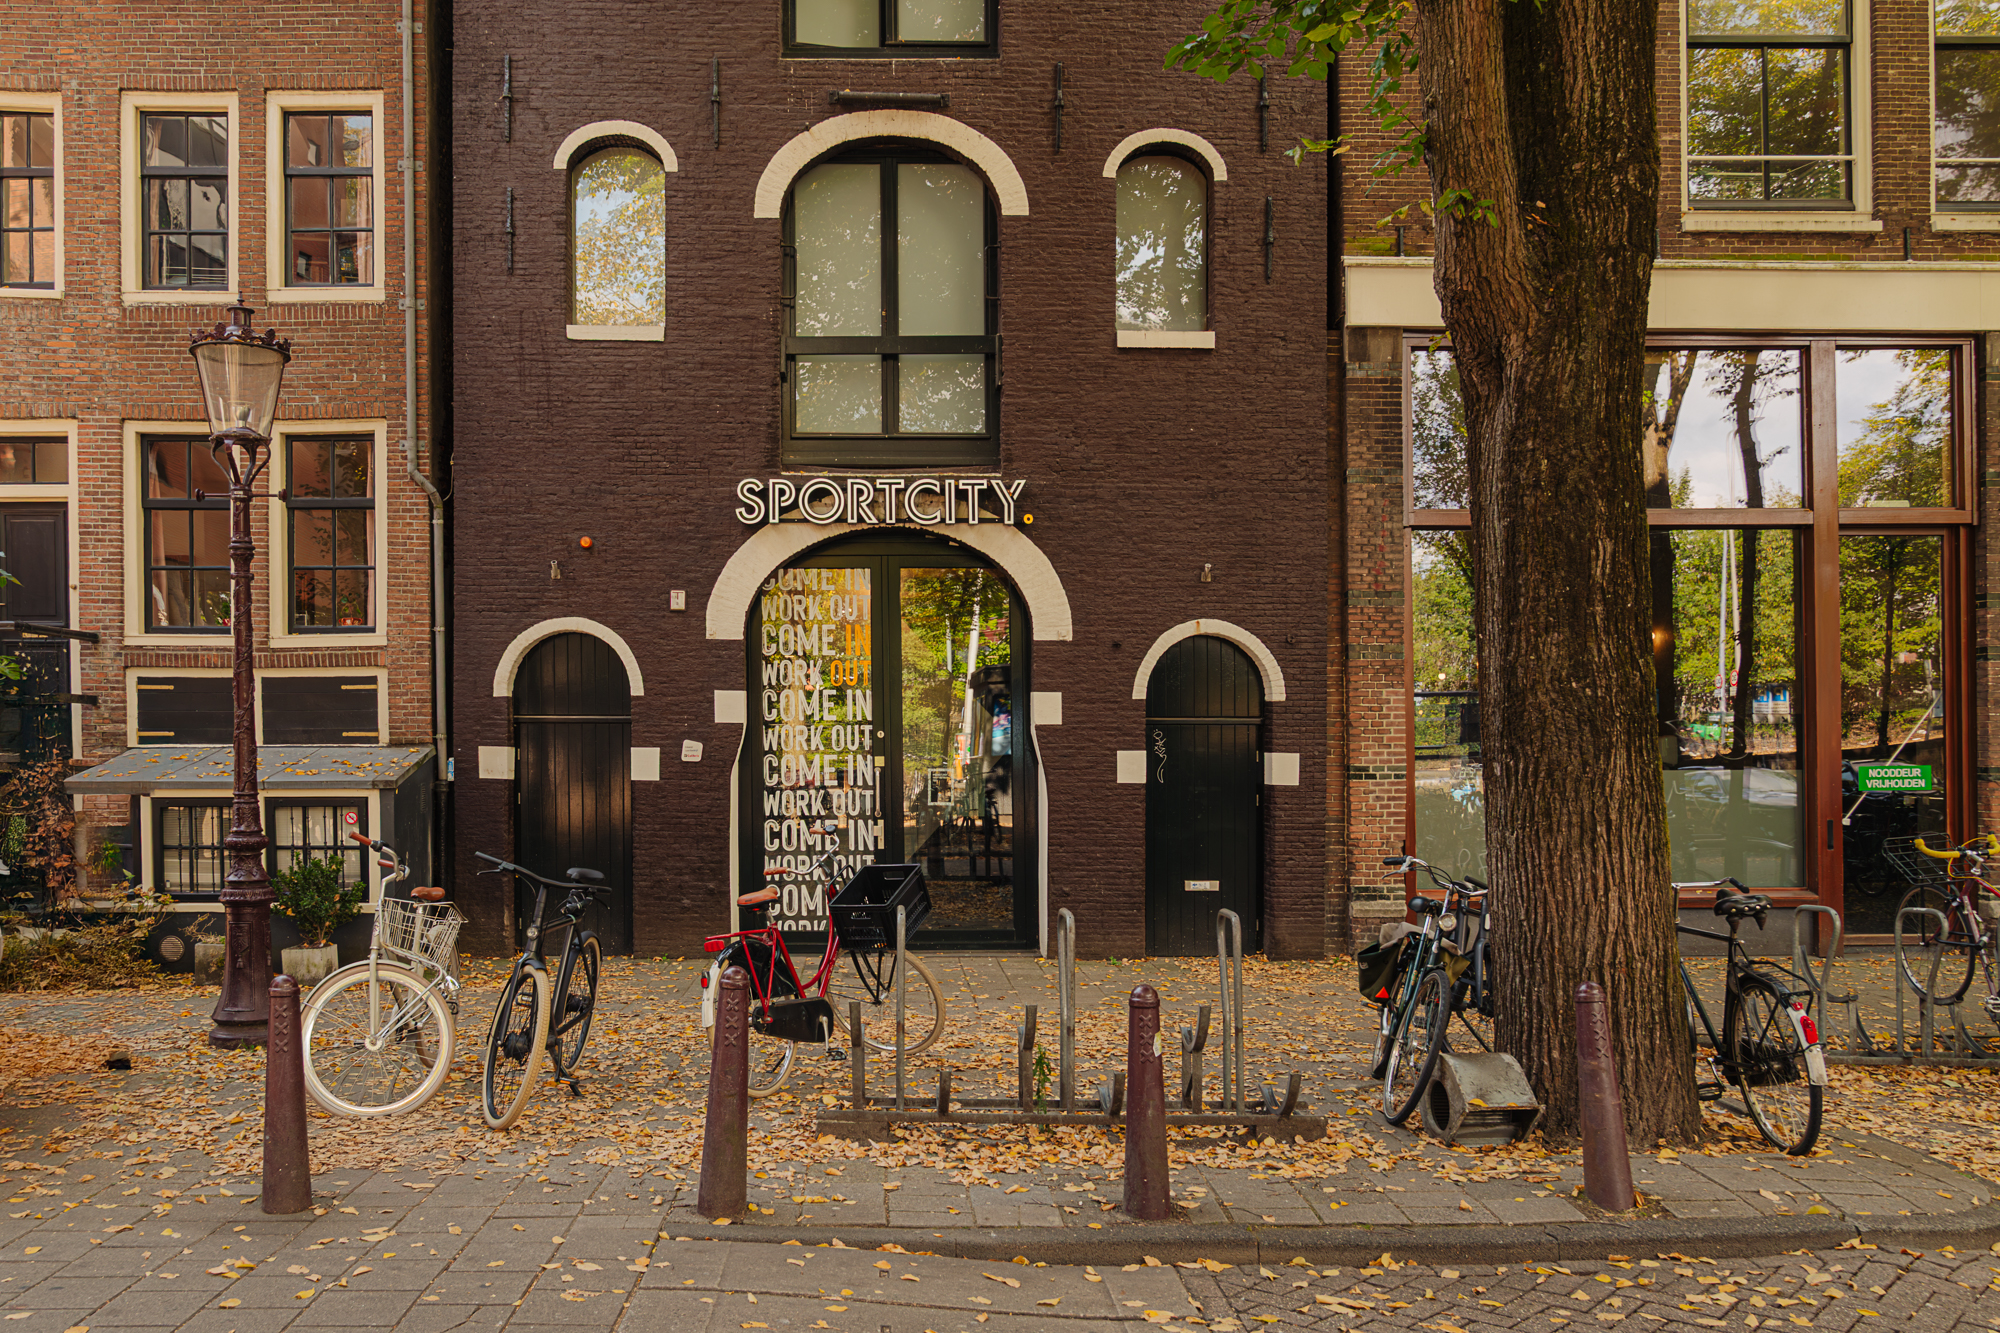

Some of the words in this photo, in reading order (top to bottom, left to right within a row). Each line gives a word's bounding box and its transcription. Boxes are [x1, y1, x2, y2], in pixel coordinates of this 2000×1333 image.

[762, 594, 823, 621] WORK
[829, 594, 871, 621] OUT
[762, 624, 836, 656] COME
[845, 624, 871, 656] IN
[762, 659, 824, 686] WORK
[830, 659, 872, 687] OUT
[763, 689, 837, 721] COME
[846, 689, 873, 721] IN
[763, 725, 824, 751] WORK
[831, 725, 873, 751] OUT
[764, 754, 838, 786] COME
[847, 754, 873, 786] IN
[1868, 768, 1921, 778] NOODDEUR
[1866, 779, 1926, 789] VRIJHOUDEN
[764, 790, 826, 816] WORK
[832, 790, 874, 816] OUT
[848, 819, 875, 851] IN
